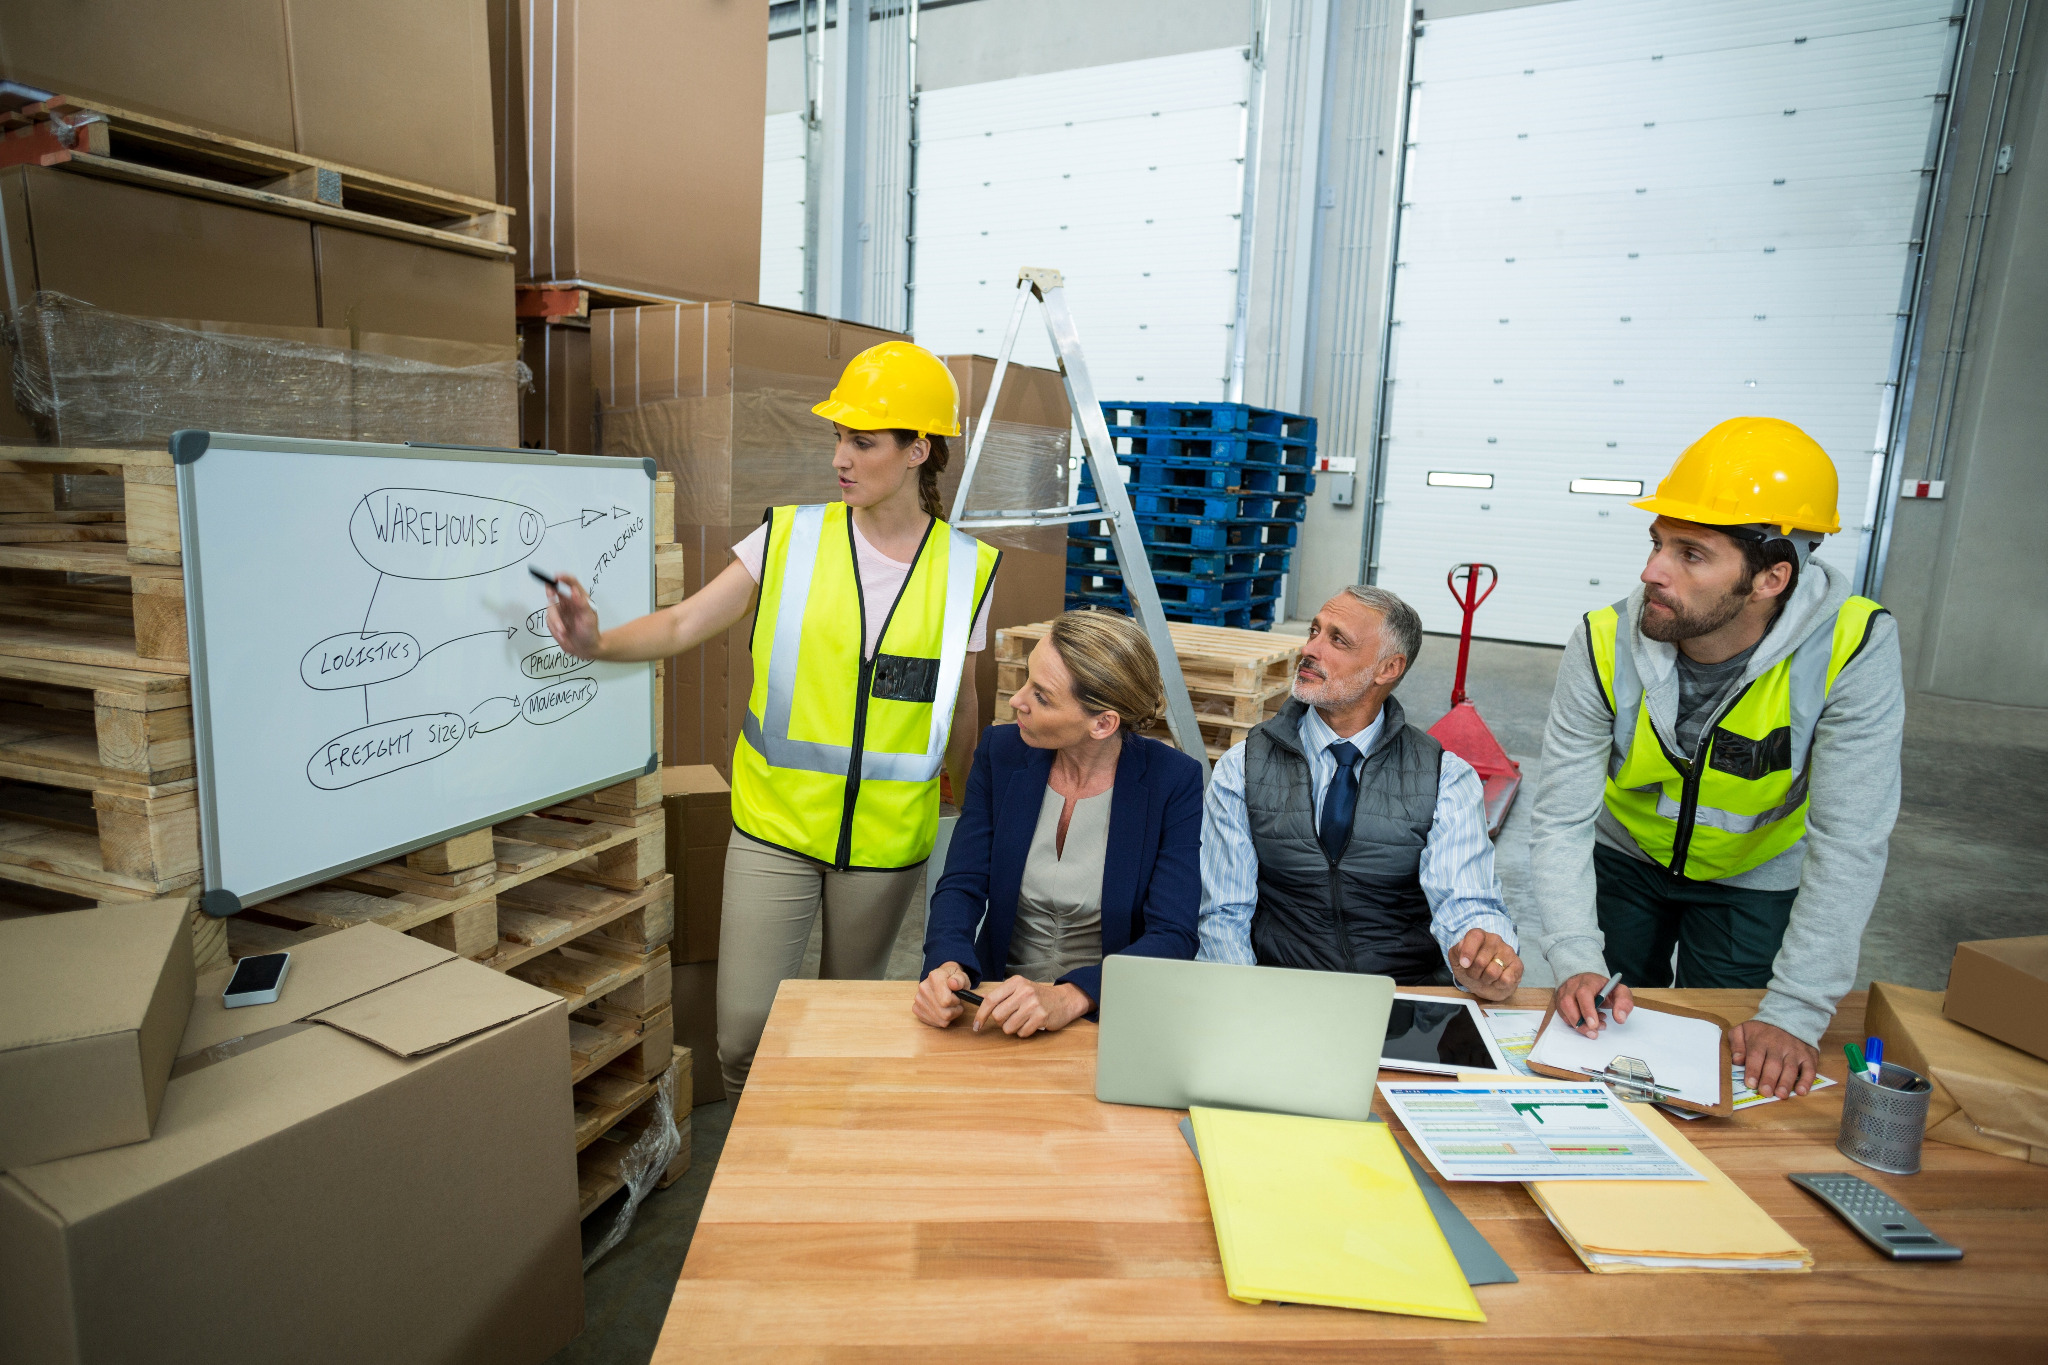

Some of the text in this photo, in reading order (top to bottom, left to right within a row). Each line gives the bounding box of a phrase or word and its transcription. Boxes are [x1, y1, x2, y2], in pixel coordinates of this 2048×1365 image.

[363, 494, 499, 547] WAREHOUSE
[594, 516, 644, 574] TRUCKING
[320, 641, 409, 675] LOGISTICS
[529, 684, 593, 714] MOVEMENTS
[324, 723, 460, 776] FREIGHT SIZE
